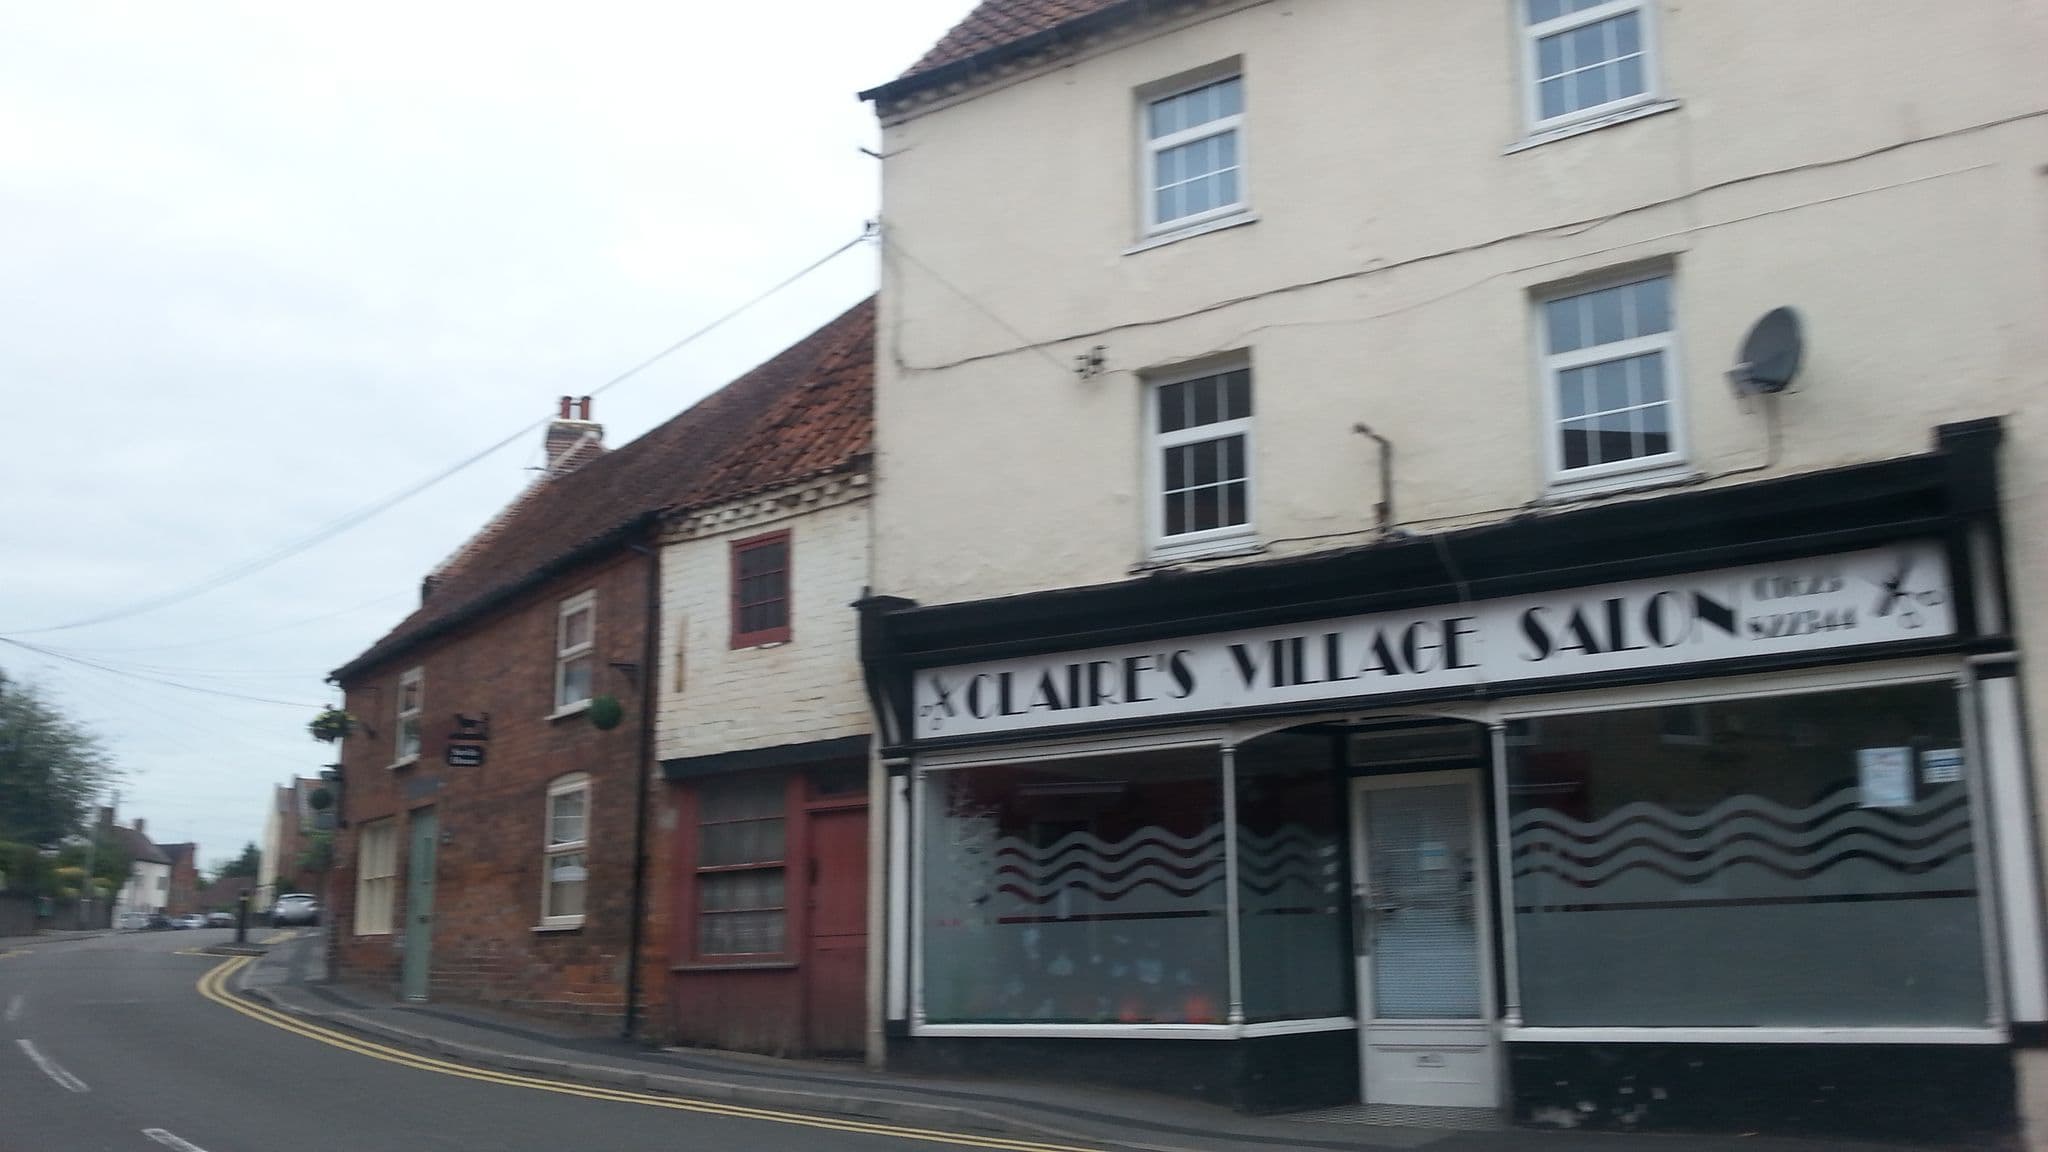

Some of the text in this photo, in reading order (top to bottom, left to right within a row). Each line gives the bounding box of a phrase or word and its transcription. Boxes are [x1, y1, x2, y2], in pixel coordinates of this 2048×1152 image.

[966, 584, 1741, 720] CLAIRE'S VILLAGE SALON
